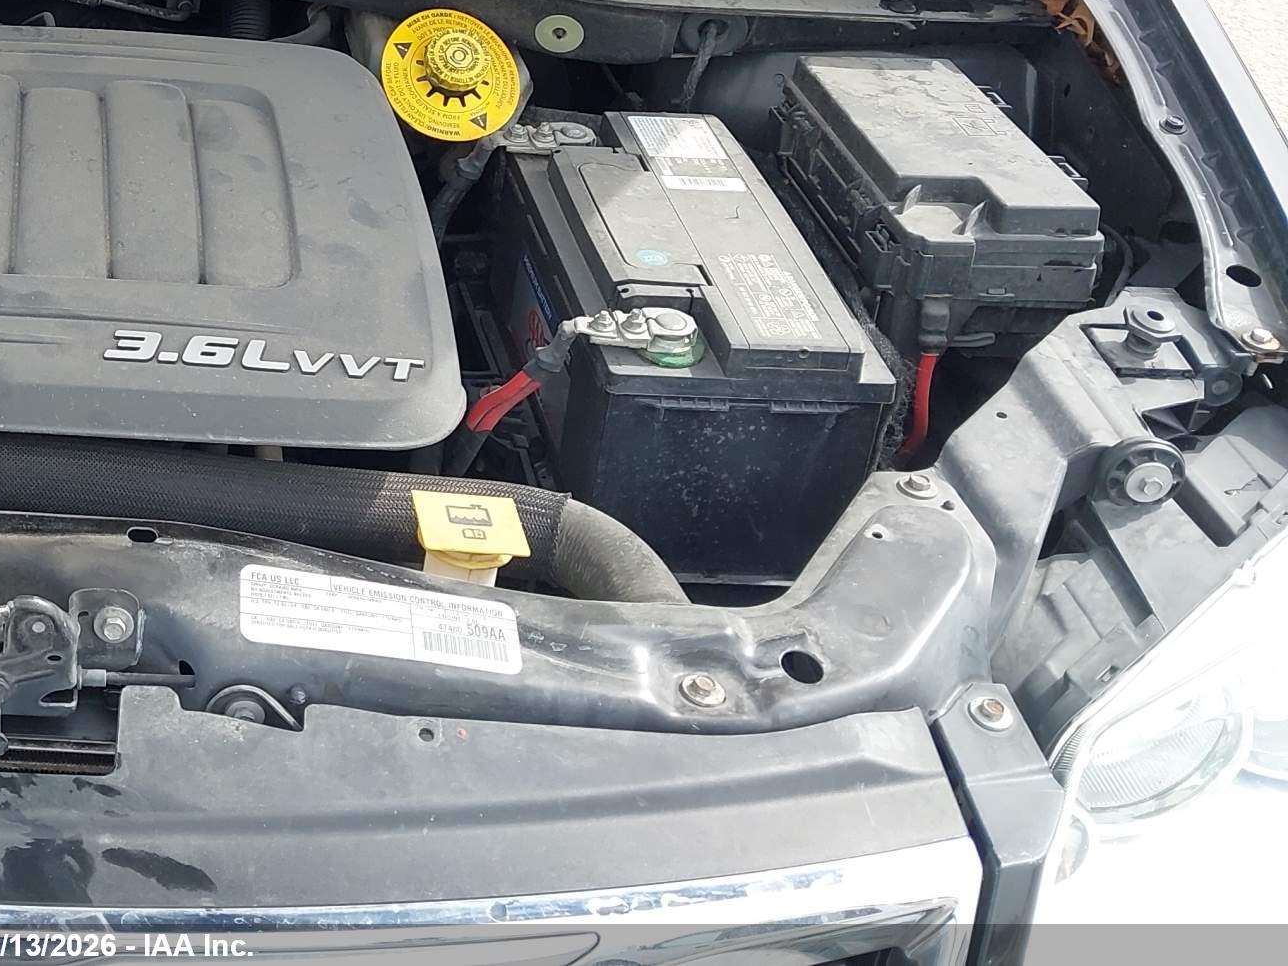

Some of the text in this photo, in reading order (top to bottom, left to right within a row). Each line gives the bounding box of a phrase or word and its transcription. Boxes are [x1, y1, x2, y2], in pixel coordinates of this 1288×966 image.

[424, 124, 461, 136] WARNING:
[251, 572, 300, 585] FCA US LLC
[333, 584, 367, 595] VEHICLE
[368, 589, 407, 602] EMISSION
[409, 595, 445, 608] CONTROL
[448, 602, 503, 617] INFORMATION
